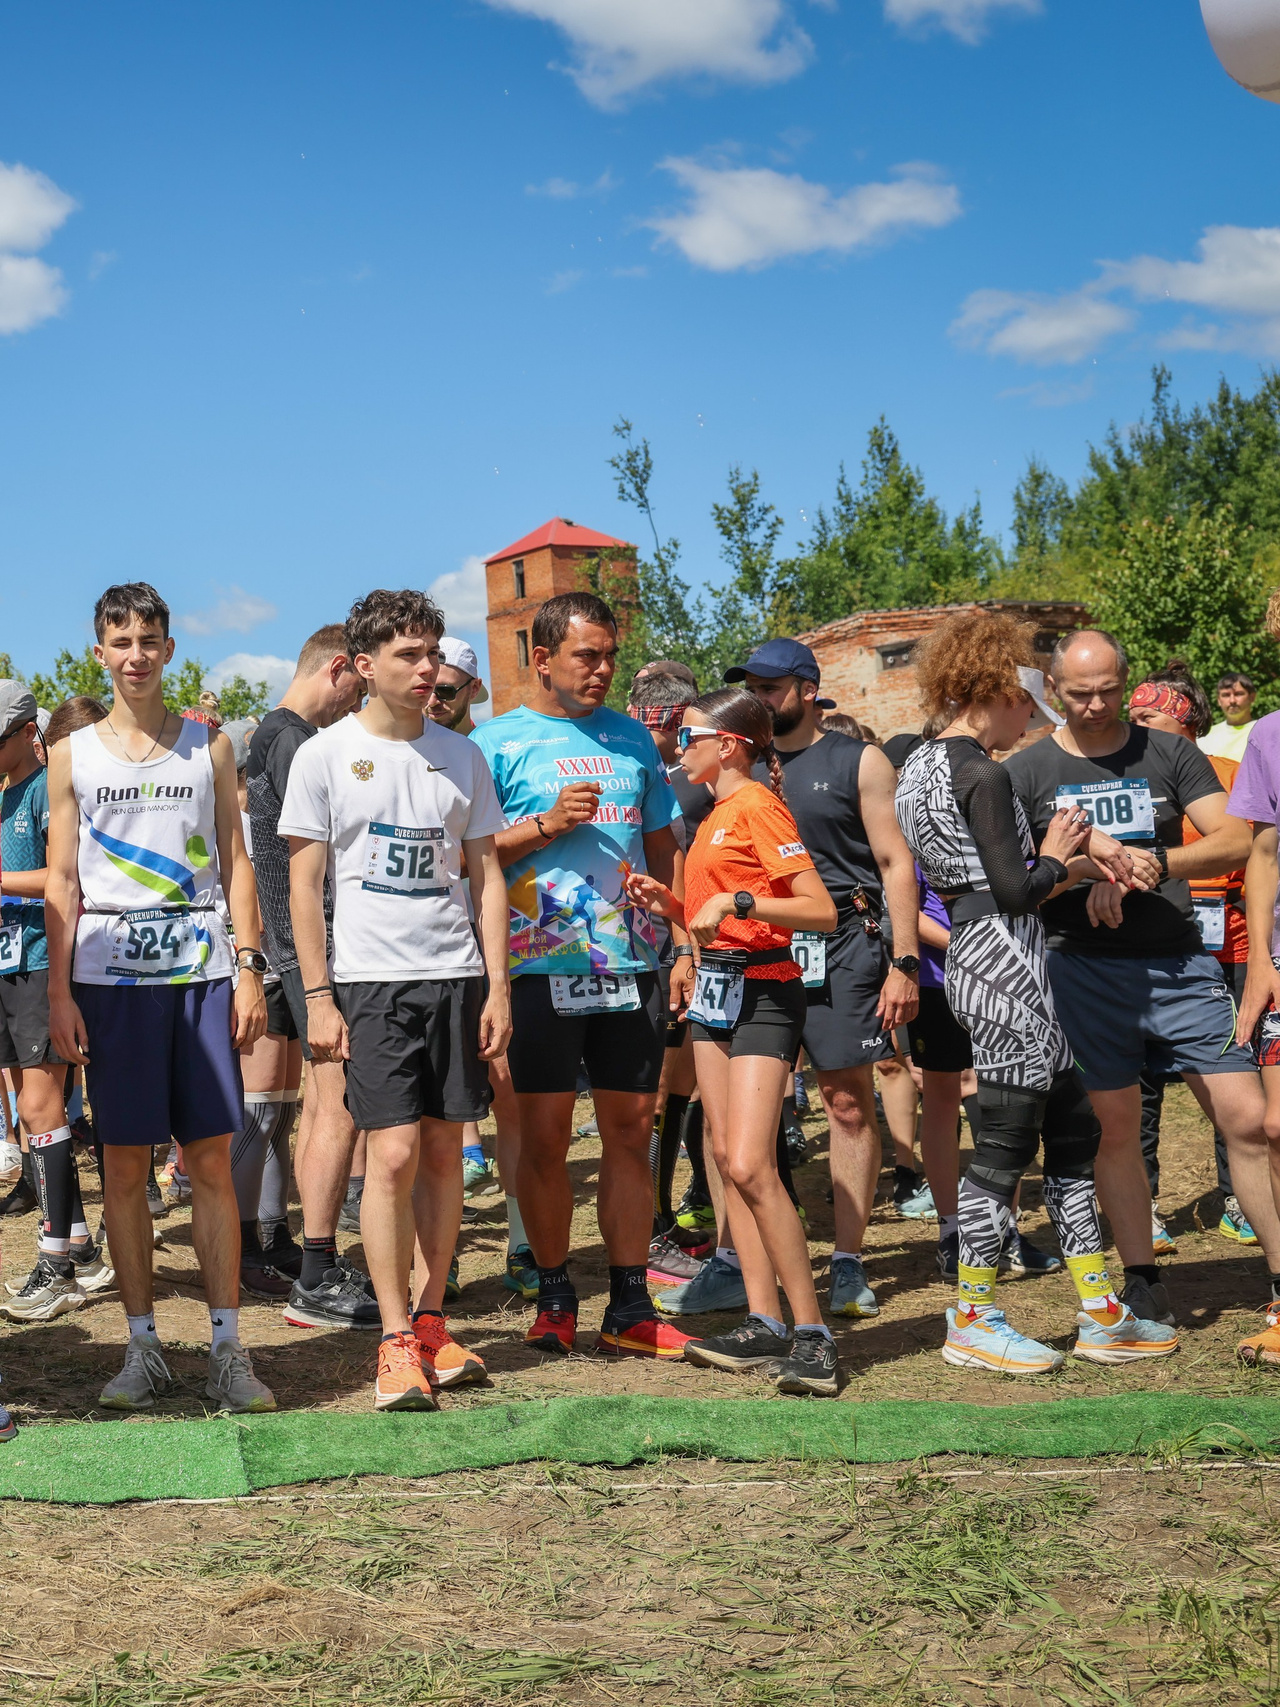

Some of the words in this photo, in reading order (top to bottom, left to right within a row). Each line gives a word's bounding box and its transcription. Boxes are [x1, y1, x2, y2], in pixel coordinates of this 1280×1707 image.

[555, 757, 614, 776] XXXIII
[96, 782, 193, 804] Run4fun
[111, 807, 126, 815] RUN
[127, 806, 146, 814] CLUB
[147, 804, 179, 812] IVANOVO
[1076, 793, 1134, 826] 508
[385, 842, 434, 879] 512
[124, 923, 181, 960] 524
[518, 941, 590, 960] МАРАФОН
[861, 1036, 883, 1049] FILA
[627, 1275, 646, 1286] RU
[949, 1329, 971, 1346] HOKA
